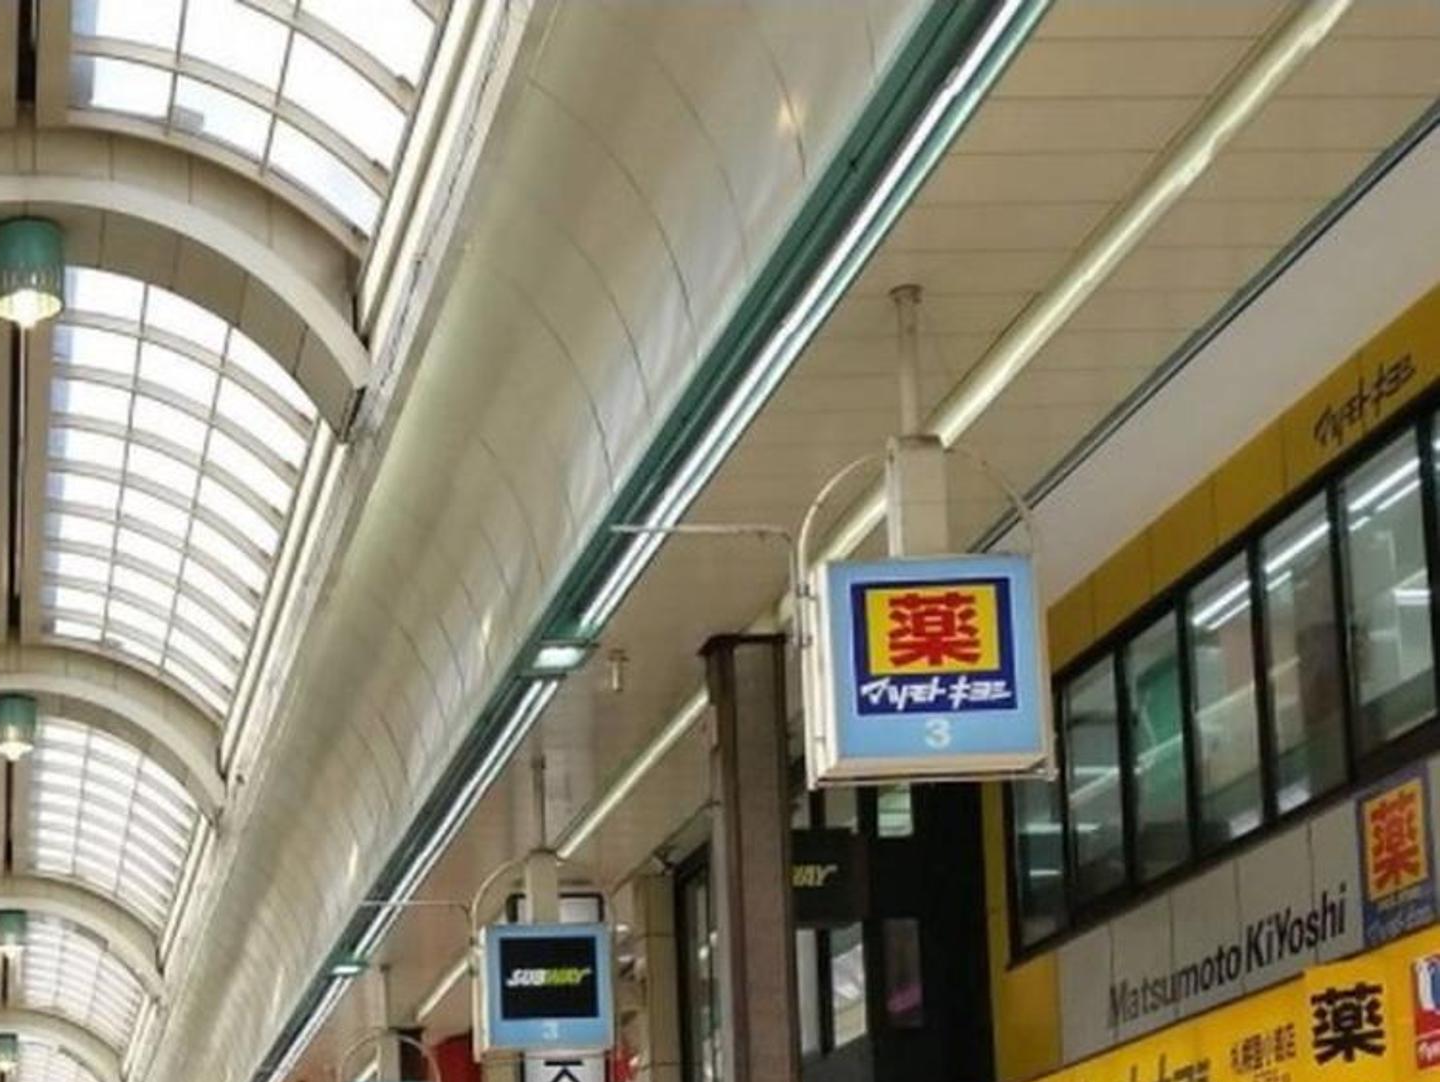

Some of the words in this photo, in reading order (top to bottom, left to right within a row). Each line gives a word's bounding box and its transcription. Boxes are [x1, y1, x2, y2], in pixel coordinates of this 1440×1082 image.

[888, 592, 981, 667] 薬
[860, 675, 1013, 711] マツモトキヨシ
[924, 718, 952, 749] 3
[1371, 791, 1421, 891] 薬
[505, 966, 592, 988] SUBWAY
[1310, 982, 1387, 1066] 薬
